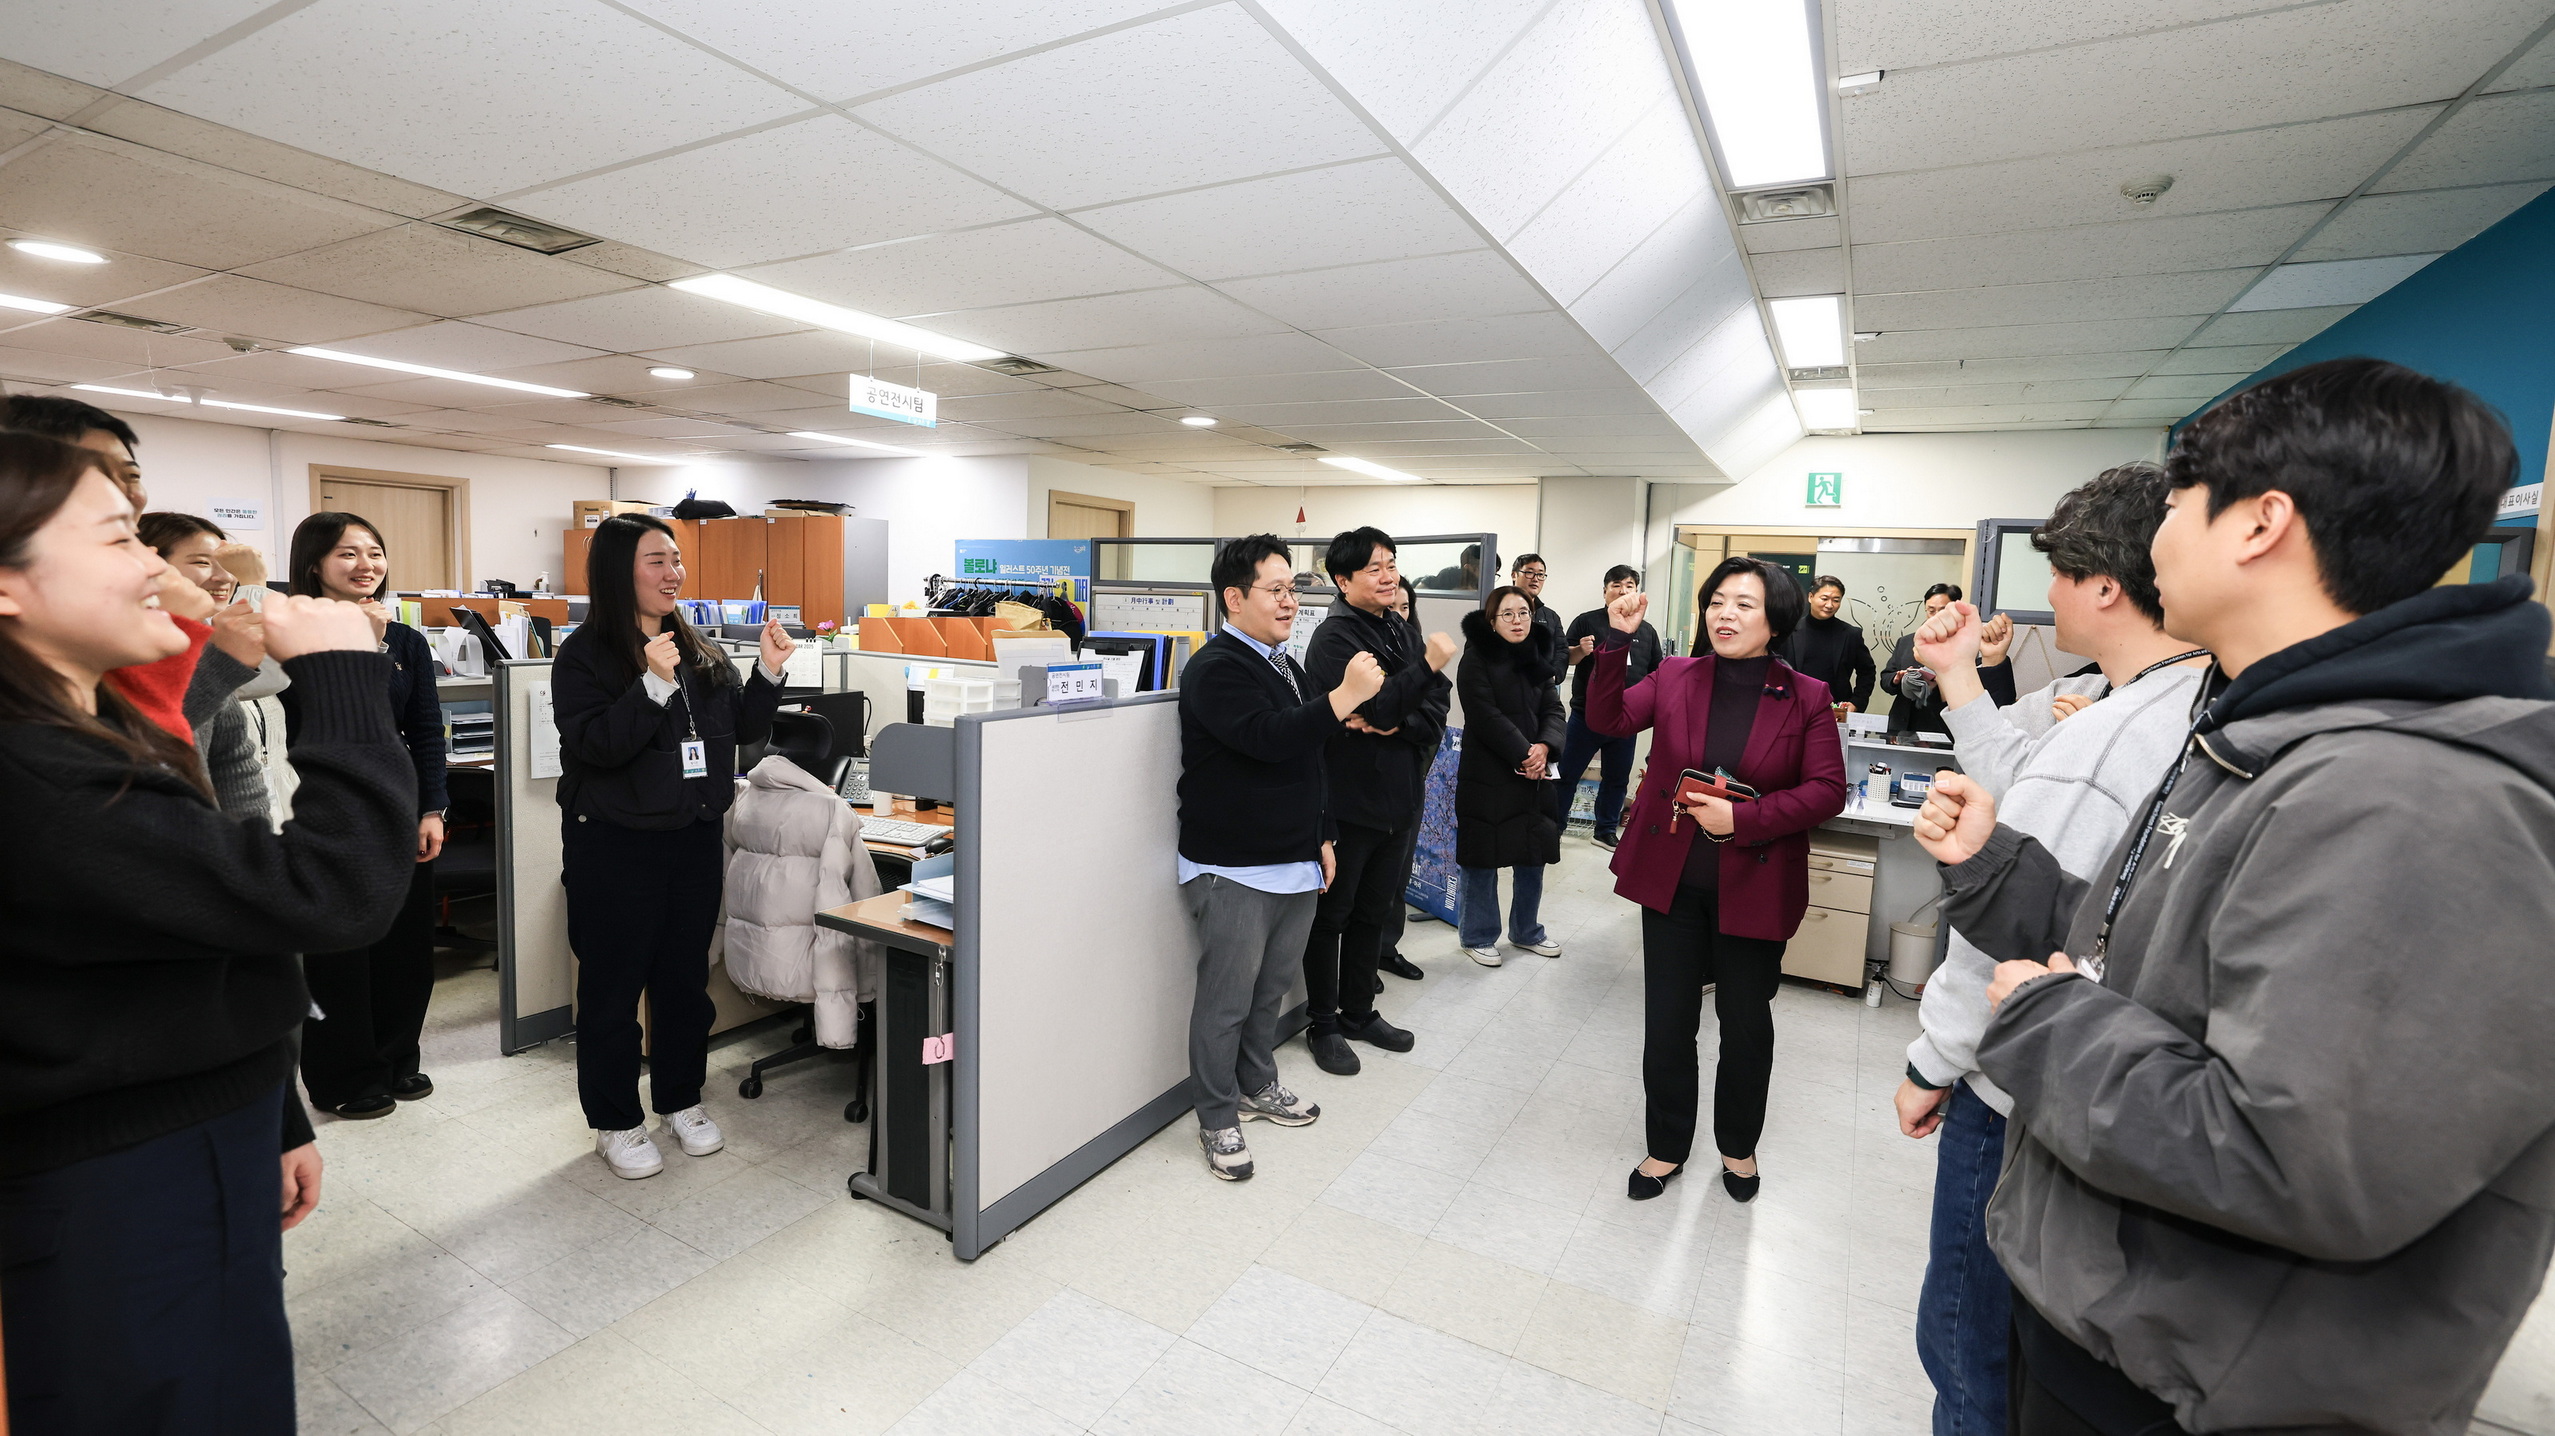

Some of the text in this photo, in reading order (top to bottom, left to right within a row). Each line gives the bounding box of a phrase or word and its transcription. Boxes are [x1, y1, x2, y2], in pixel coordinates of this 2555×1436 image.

[867, 386, 923, 413] 공연전시팀
[2500, 490, 2539, 508] 대표이사실
[964, 558, 1070, 576] 볼로냐 일러스트 50주년 기념전
[2161, 655, 2186, 666] Foundation
[2137, 826, 2152, 853] Foundation
[1444, 875, 1457, 911] EXHIBITION
